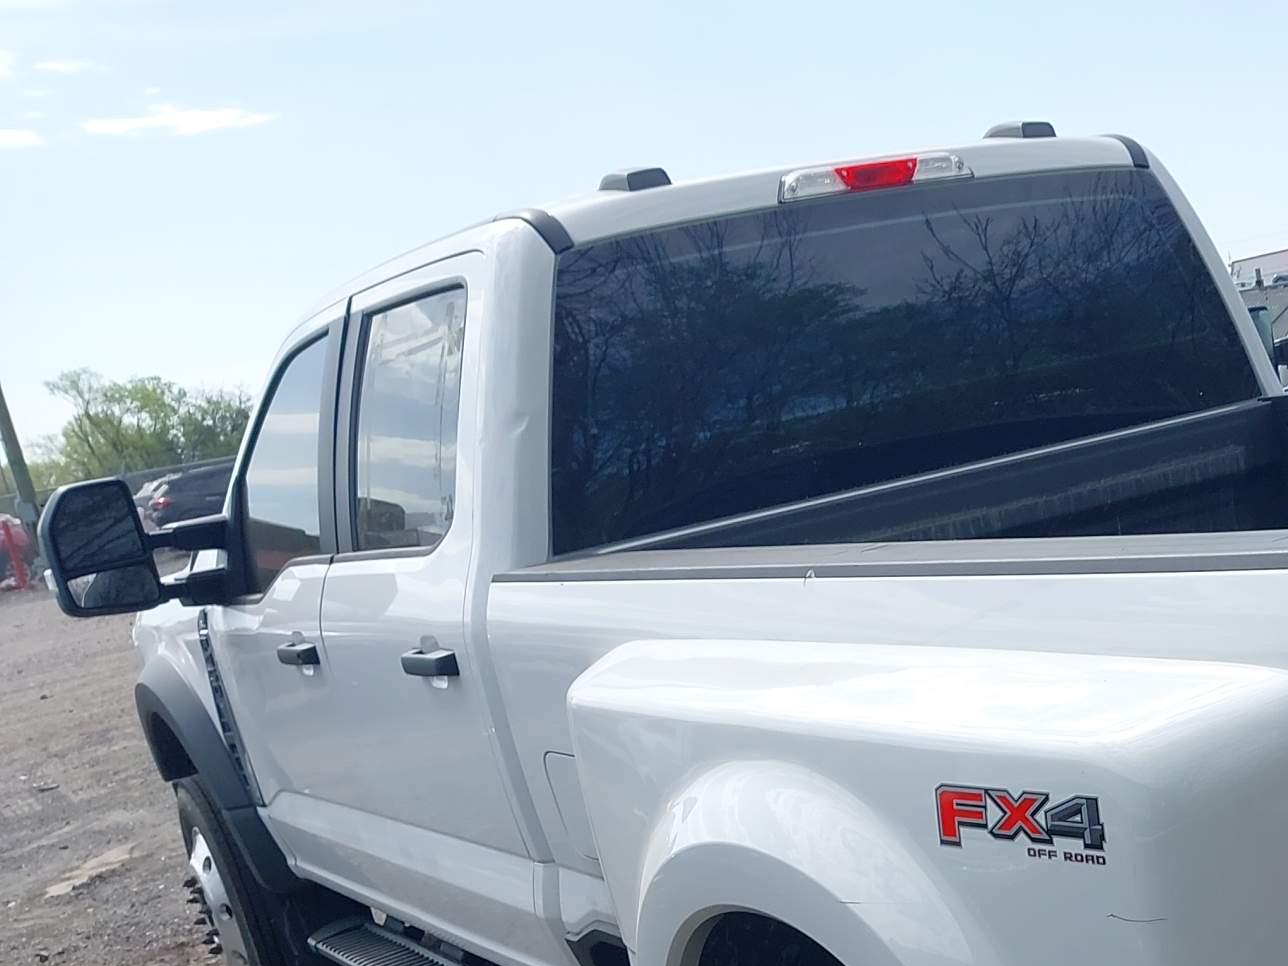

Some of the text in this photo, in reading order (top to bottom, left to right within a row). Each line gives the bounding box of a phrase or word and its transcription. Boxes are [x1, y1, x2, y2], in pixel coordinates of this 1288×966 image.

[934, 783, 1107, 850] FX4
[1026, 847, 1107, 866] OFF ROAD
